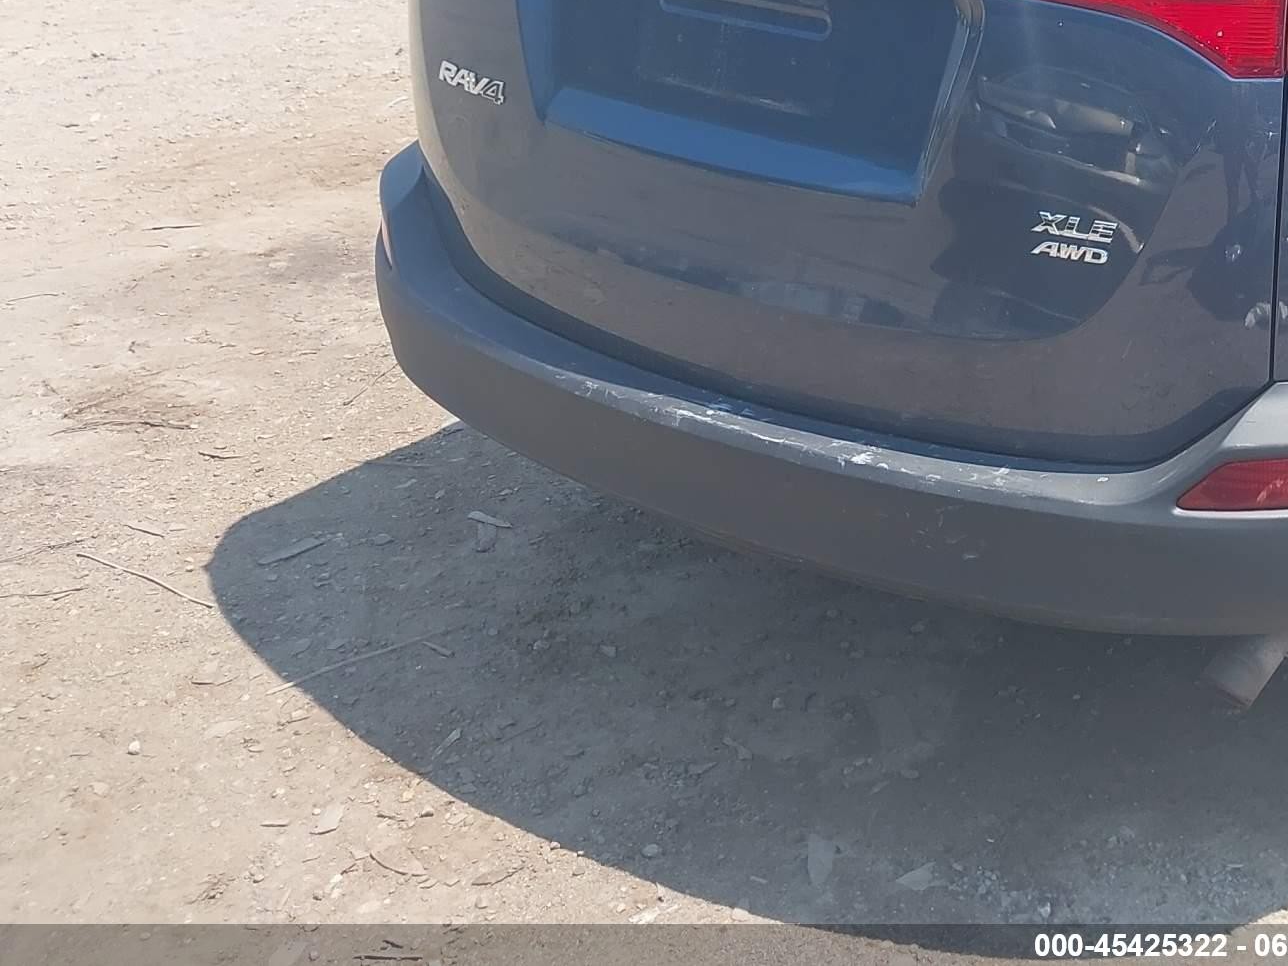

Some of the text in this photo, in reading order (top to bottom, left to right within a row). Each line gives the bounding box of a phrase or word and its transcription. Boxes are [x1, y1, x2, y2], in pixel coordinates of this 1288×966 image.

[438, 60, 505, 105] RAV4
[1031, 211, 1119, 243] XLE
[1030, 241, 1108, 264] AWD
